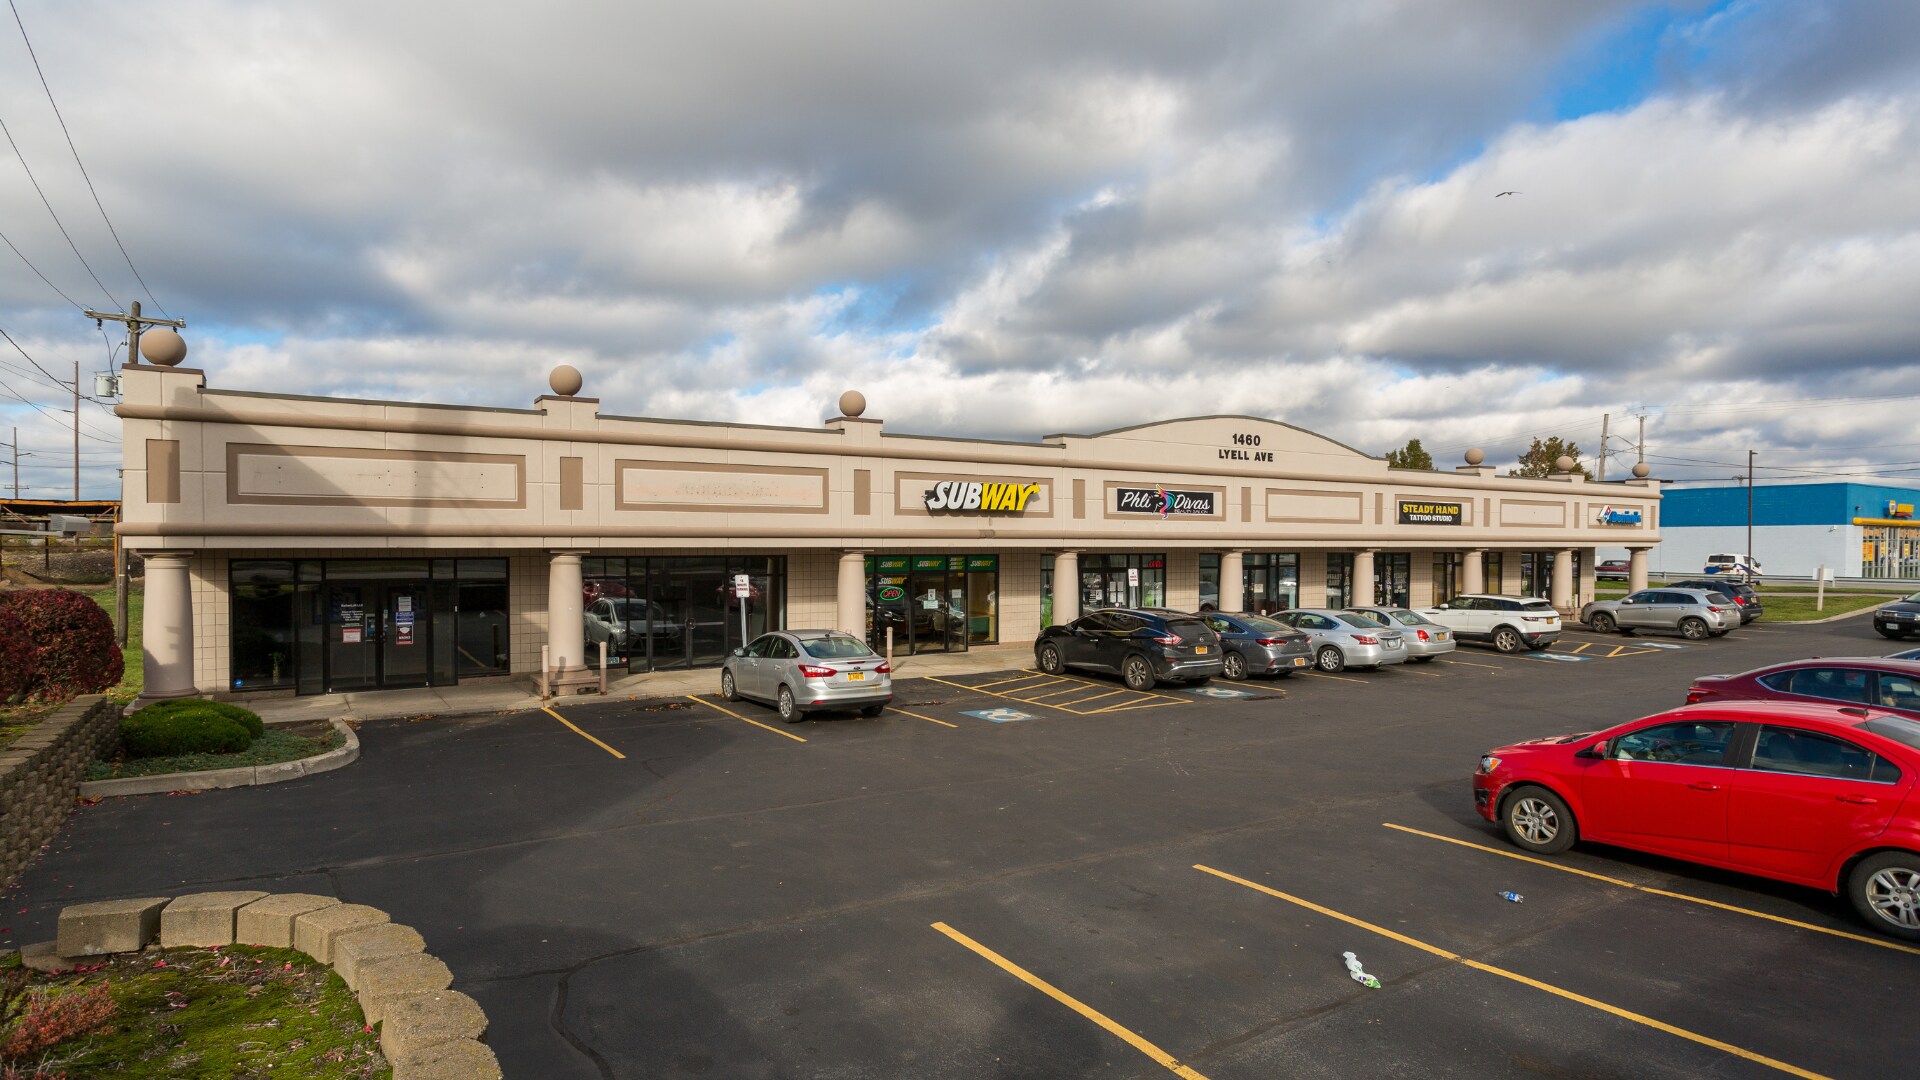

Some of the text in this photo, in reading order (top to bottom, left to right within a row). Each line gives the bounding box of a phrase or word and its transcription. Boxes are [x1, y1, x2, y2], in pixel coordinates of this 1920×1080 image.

[1232, 433, 1261, 447] 1460
[1218, 449, 1274, 462] LYELL AVE
[926, 481, 1040, 511] SUBWAY
[1121, 491, 1211, 510] Phli Divas
[1402, 504, 1459, 515] STEADY HAND
[878, 577, 908, 585] SUBWAY
[882, 589, 901, 598] OPEN
